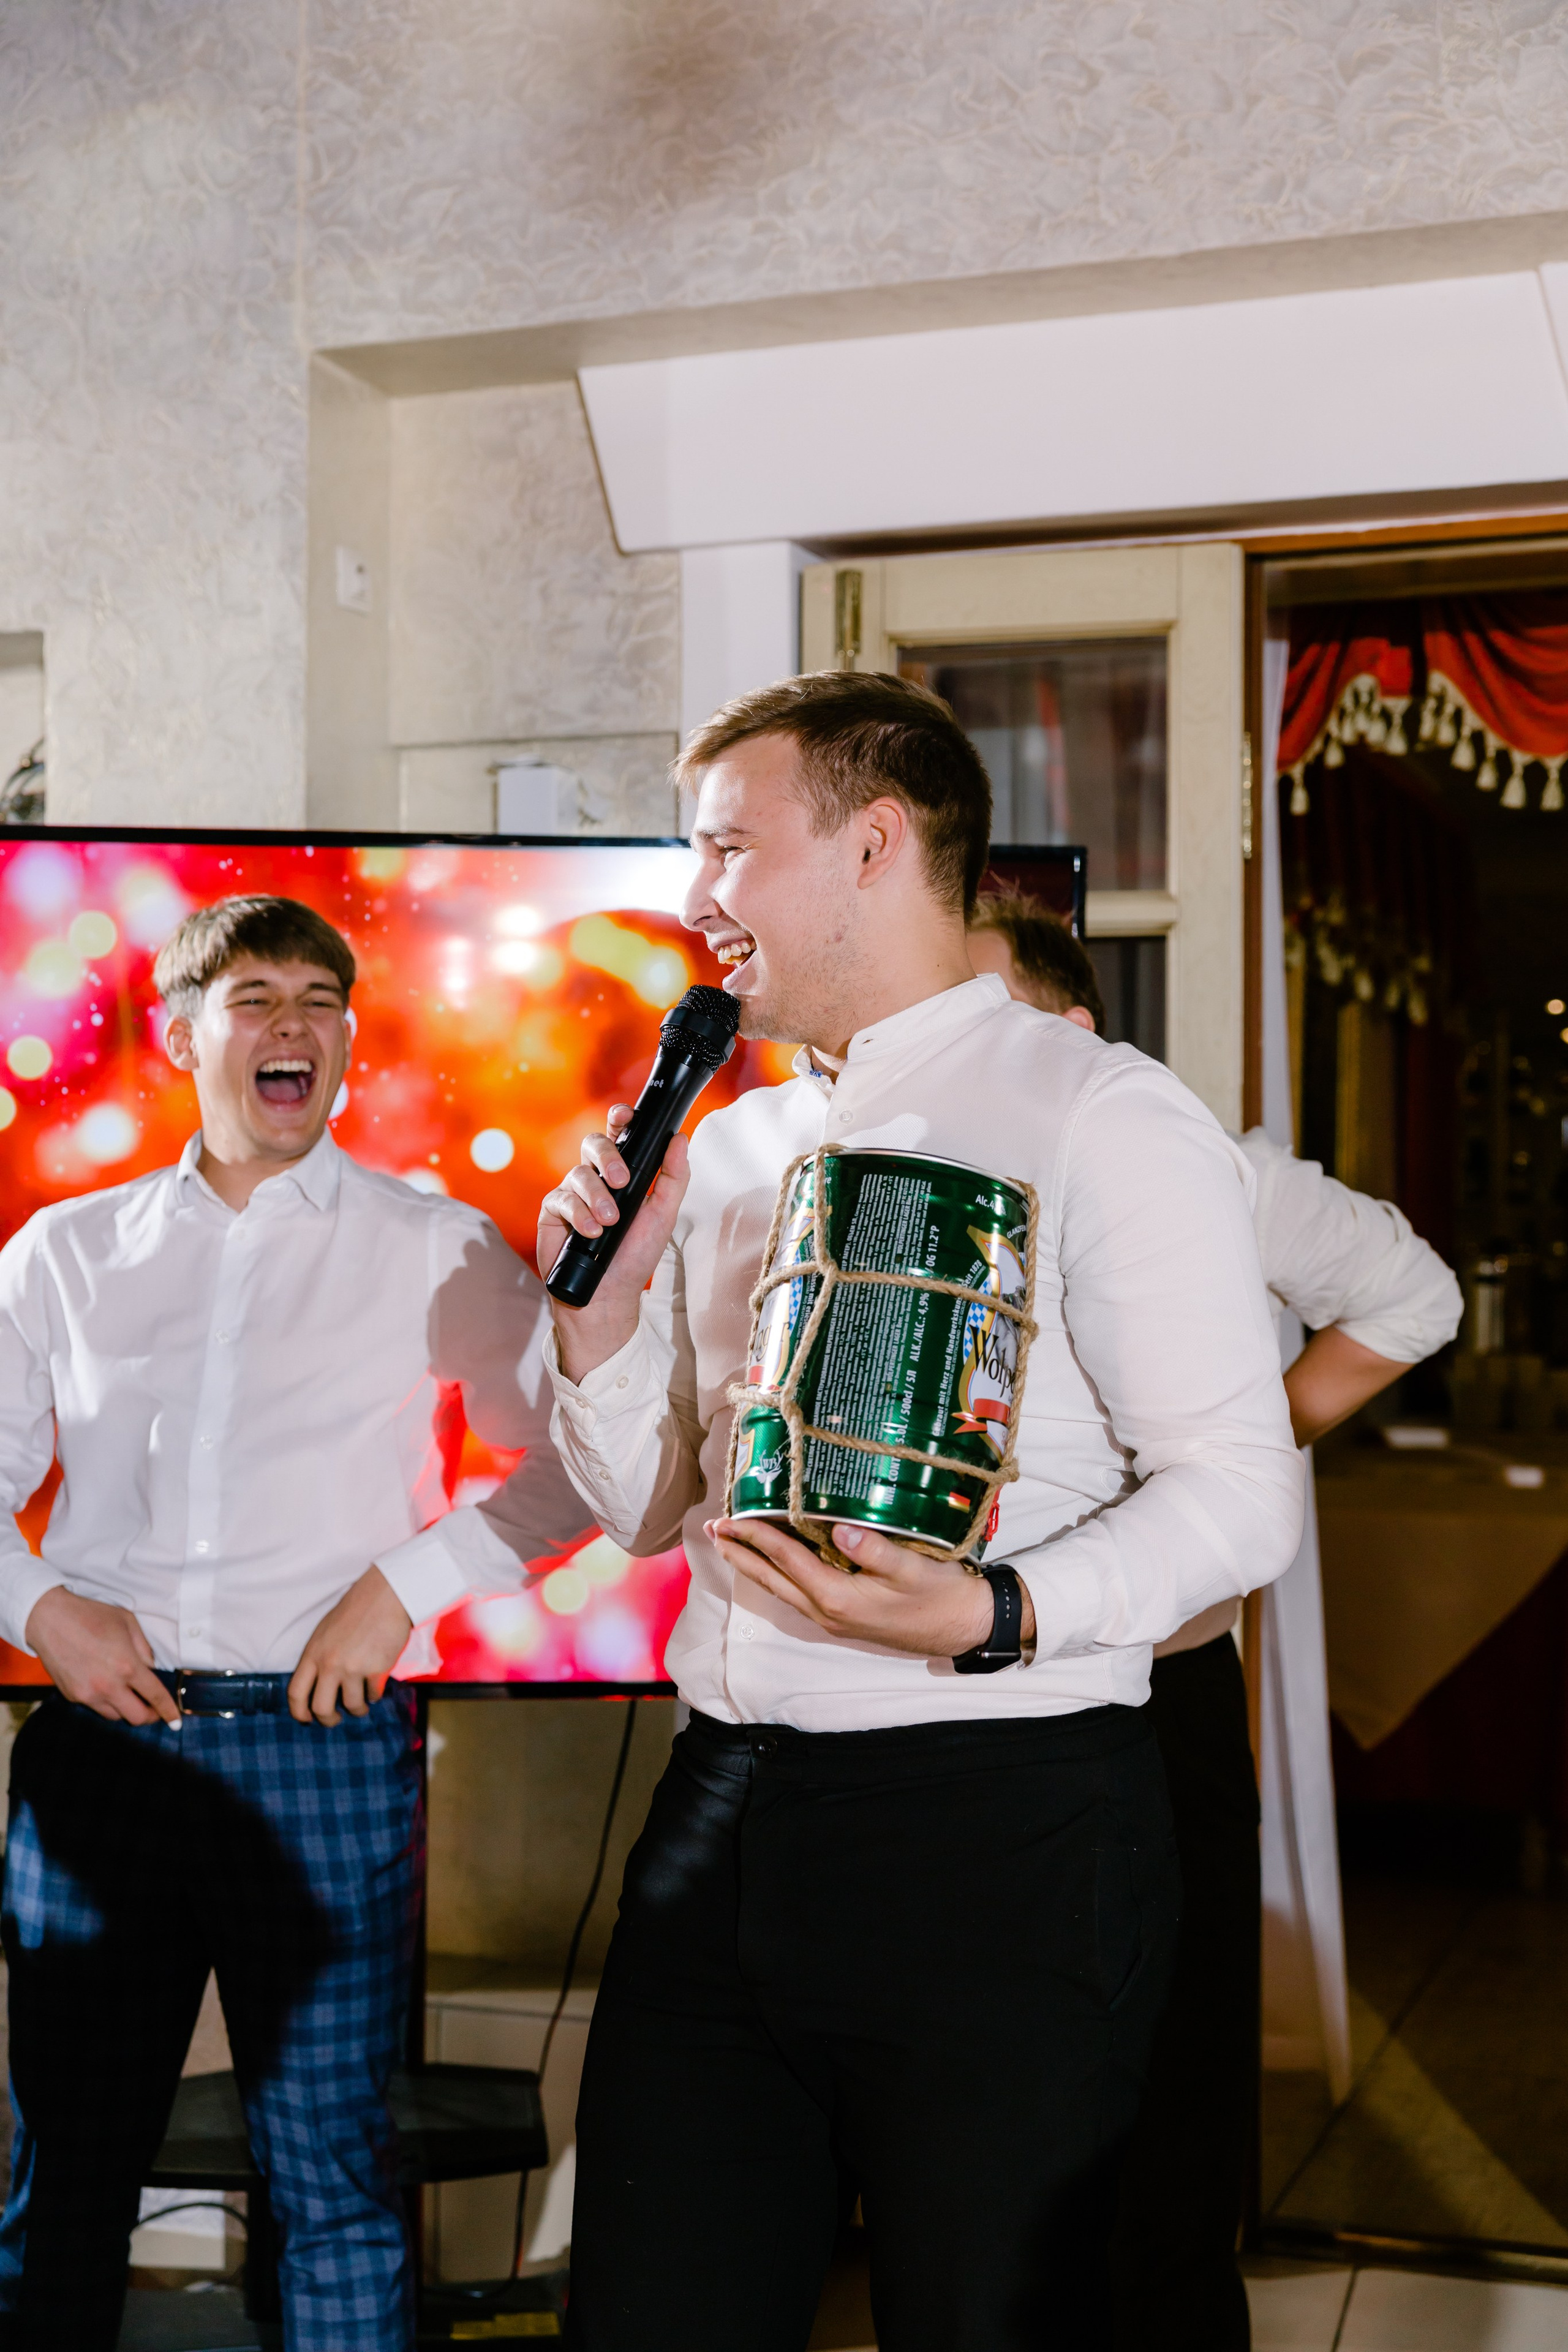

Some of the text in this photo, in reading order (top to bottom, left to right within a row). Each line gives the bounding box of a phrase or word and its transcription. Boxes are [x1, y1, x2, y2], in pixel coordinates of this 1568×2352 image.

[897, 1219, 909, 1254] WOLPERTINGER
[903, 1205, 912, 1220] LAGER
[927, 1224, 941, 1253] 11.2°P
[924, 1253, 937, 1267] OG
[969, 1259, 982, 1274] 1878
[916, 1291, 931, 1316] 4,9%
[824, 1317, 837, 1354] WOLPERTINGER
[831, 1301, 840, 1317] LAGER
[892, 1328, 902, 1344] LAGER
[944, 1295, 963, 1354] Handwerkskuns
[908, 1315, 926, 1362] ALK./ALC.:
[951, 1328, 962, 1363] DEUTSCHLAND
[886, 1344, 899, 1382] WOLPERTINGER
[942, 1354, 952, 1370] und
[938, 1370, 950, 1390] Herz
[899, 1389, 914, 1415] 500cl
[936, 1390, 946, 1405] mit
[894, 1422, 908, 1444] 5.0L
[931, 1404, 944, 1437] Gebraut
[883, 1482, 897, 1505] INH.
